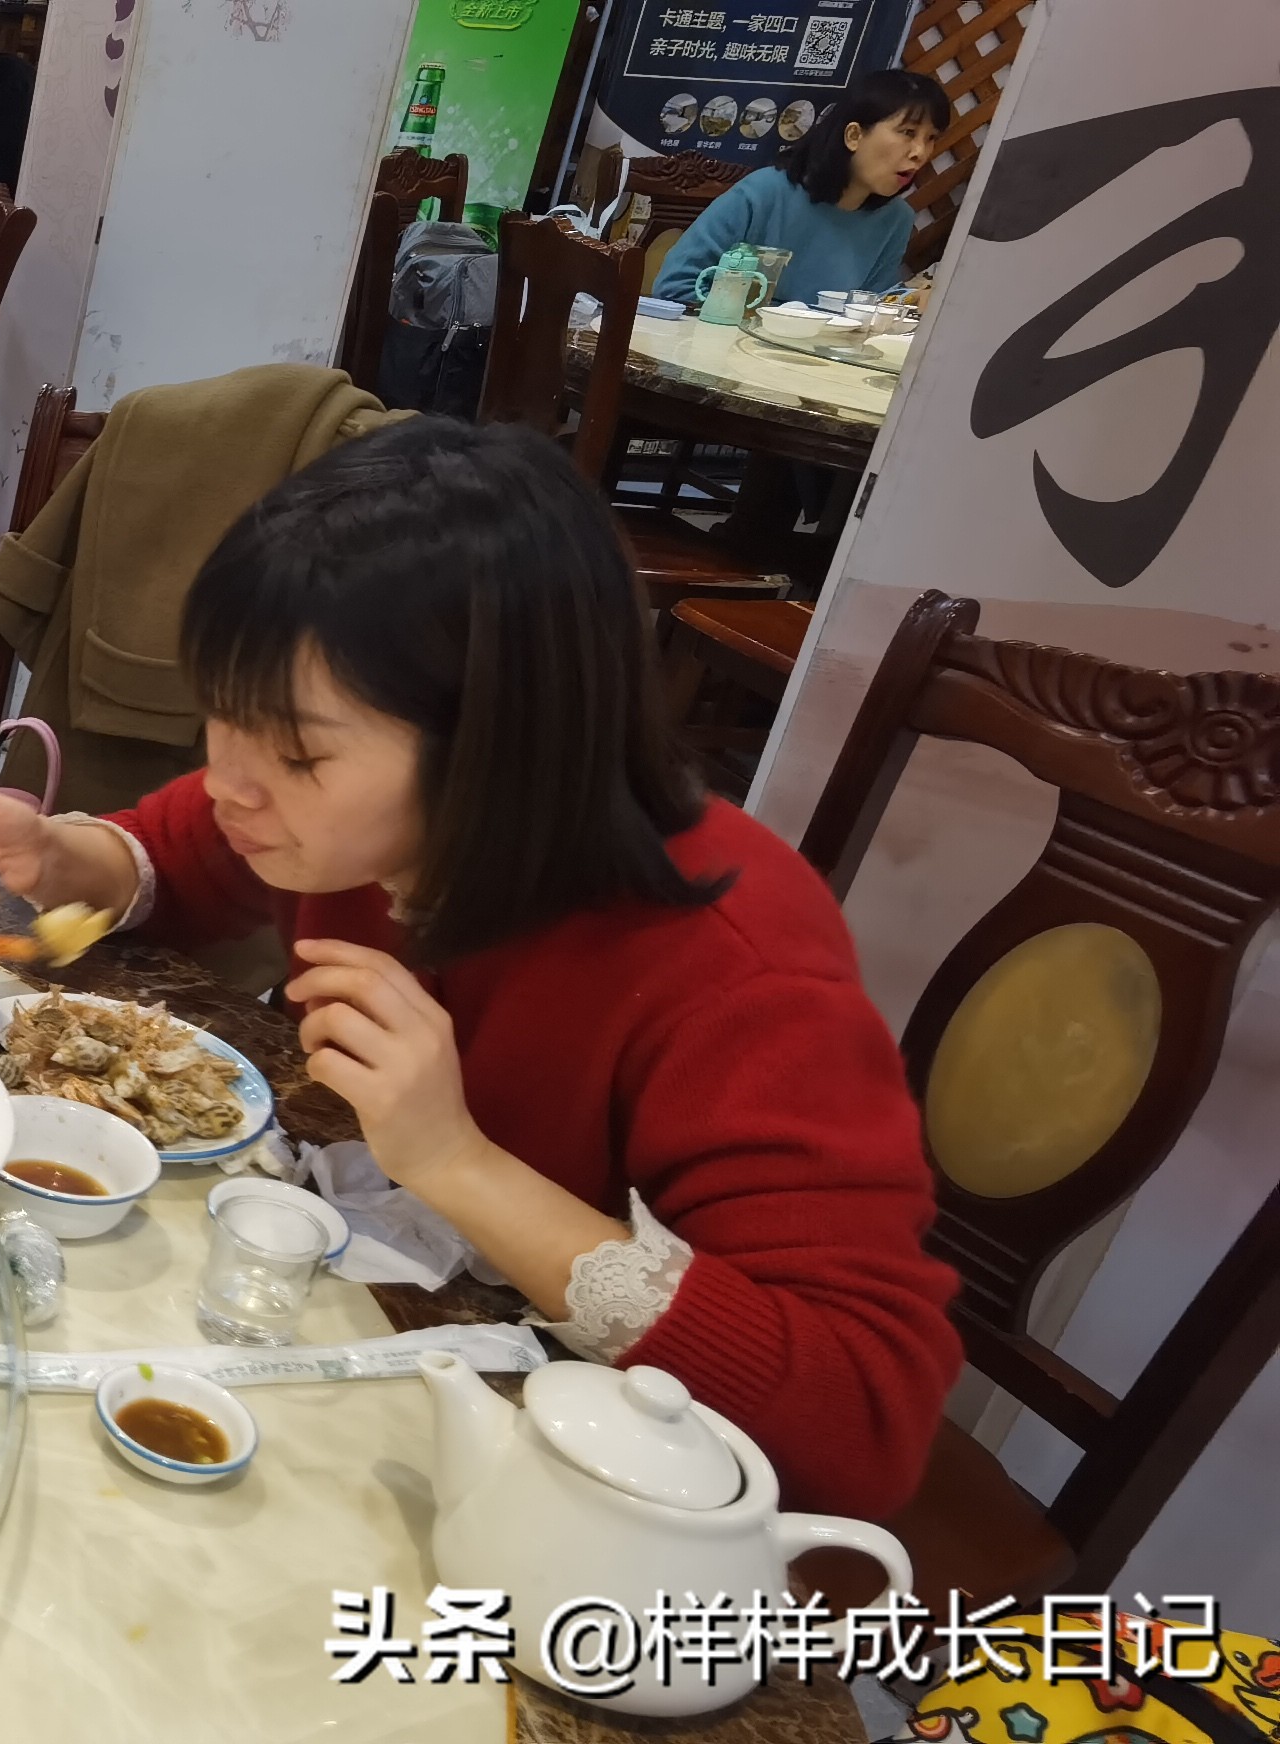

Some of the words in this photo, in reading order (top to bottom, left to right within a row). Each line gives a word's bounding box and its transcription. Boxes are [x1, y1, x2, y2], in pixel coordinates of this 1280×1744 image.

[658, 8, 799, 33] 卡通主题，一家四口
[649, 38, 789, 63] 亲子时光，趣味无限
